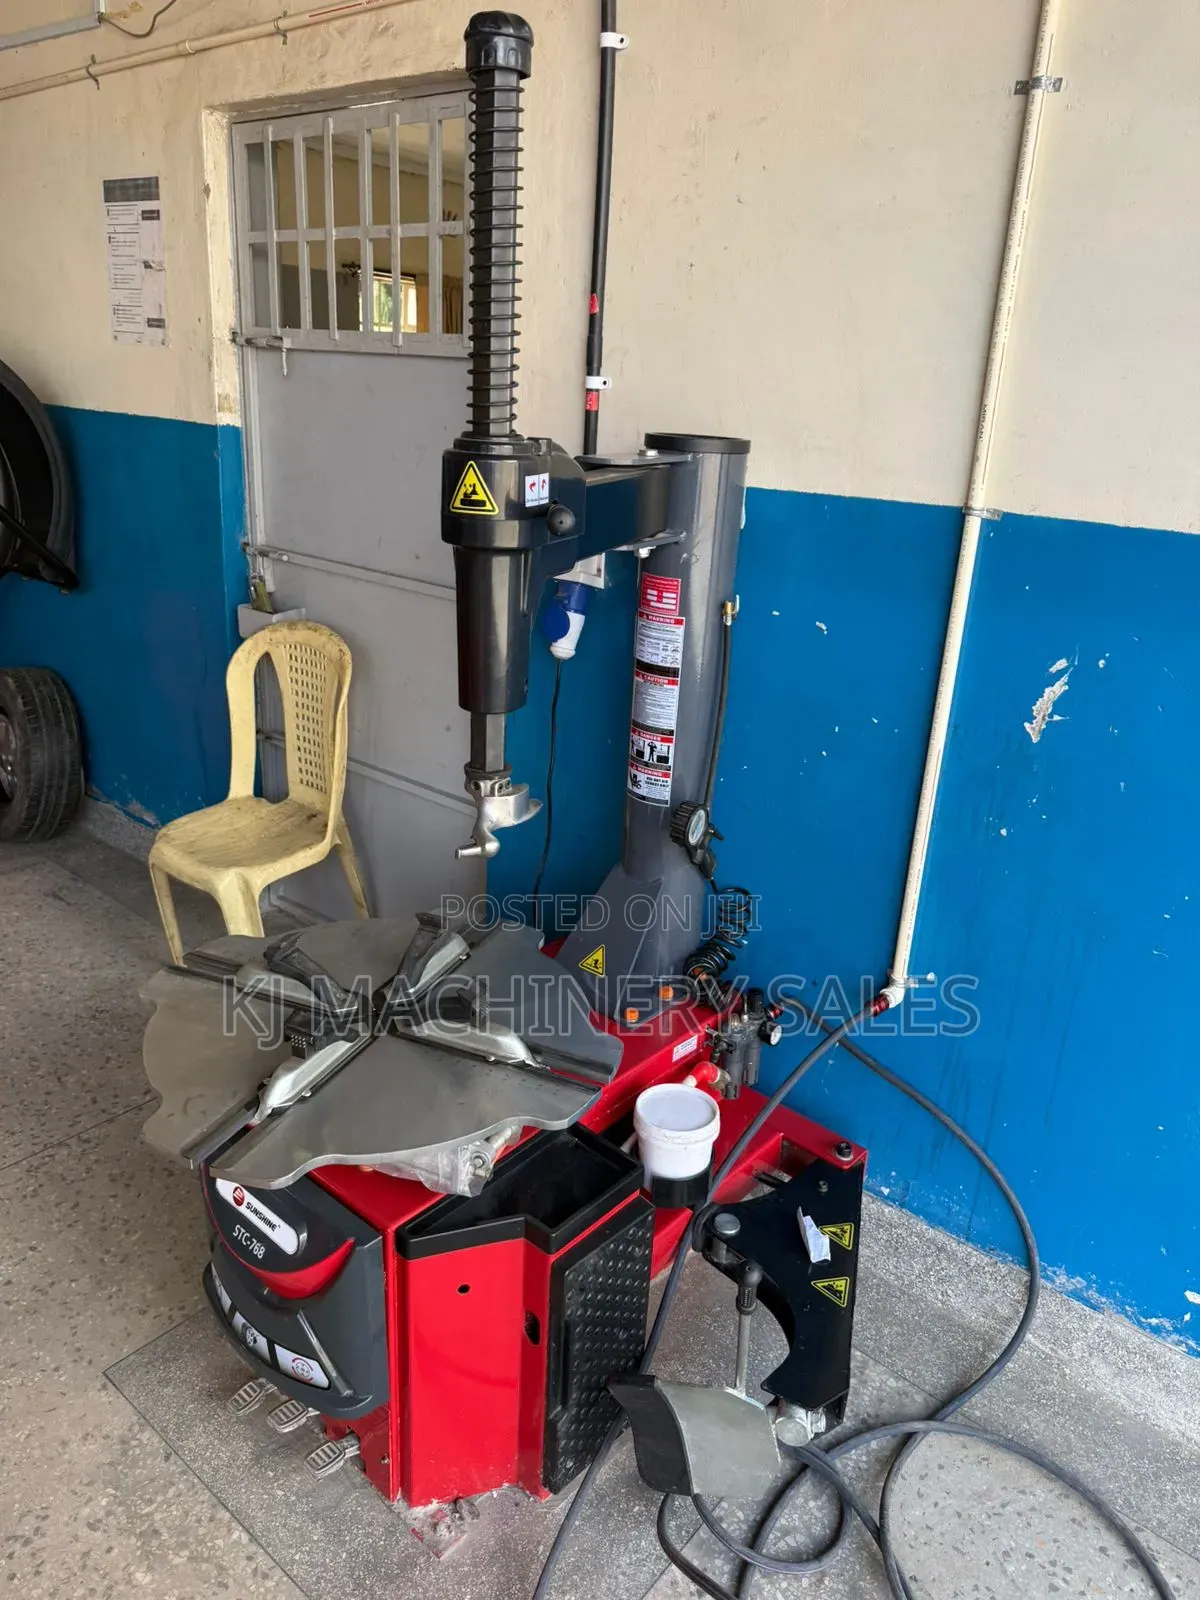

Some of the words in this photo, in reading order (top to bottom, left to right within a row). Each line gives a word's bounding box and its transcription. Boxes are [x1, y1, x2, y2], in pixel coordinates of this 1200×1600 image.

[648, 615, 675, 624] WARNING
[644, 674, 669, 684] CAUTION
[245, 1201, 278, 1232] SUNSHINE
[232, 1224, 265, 1259] STC-768
